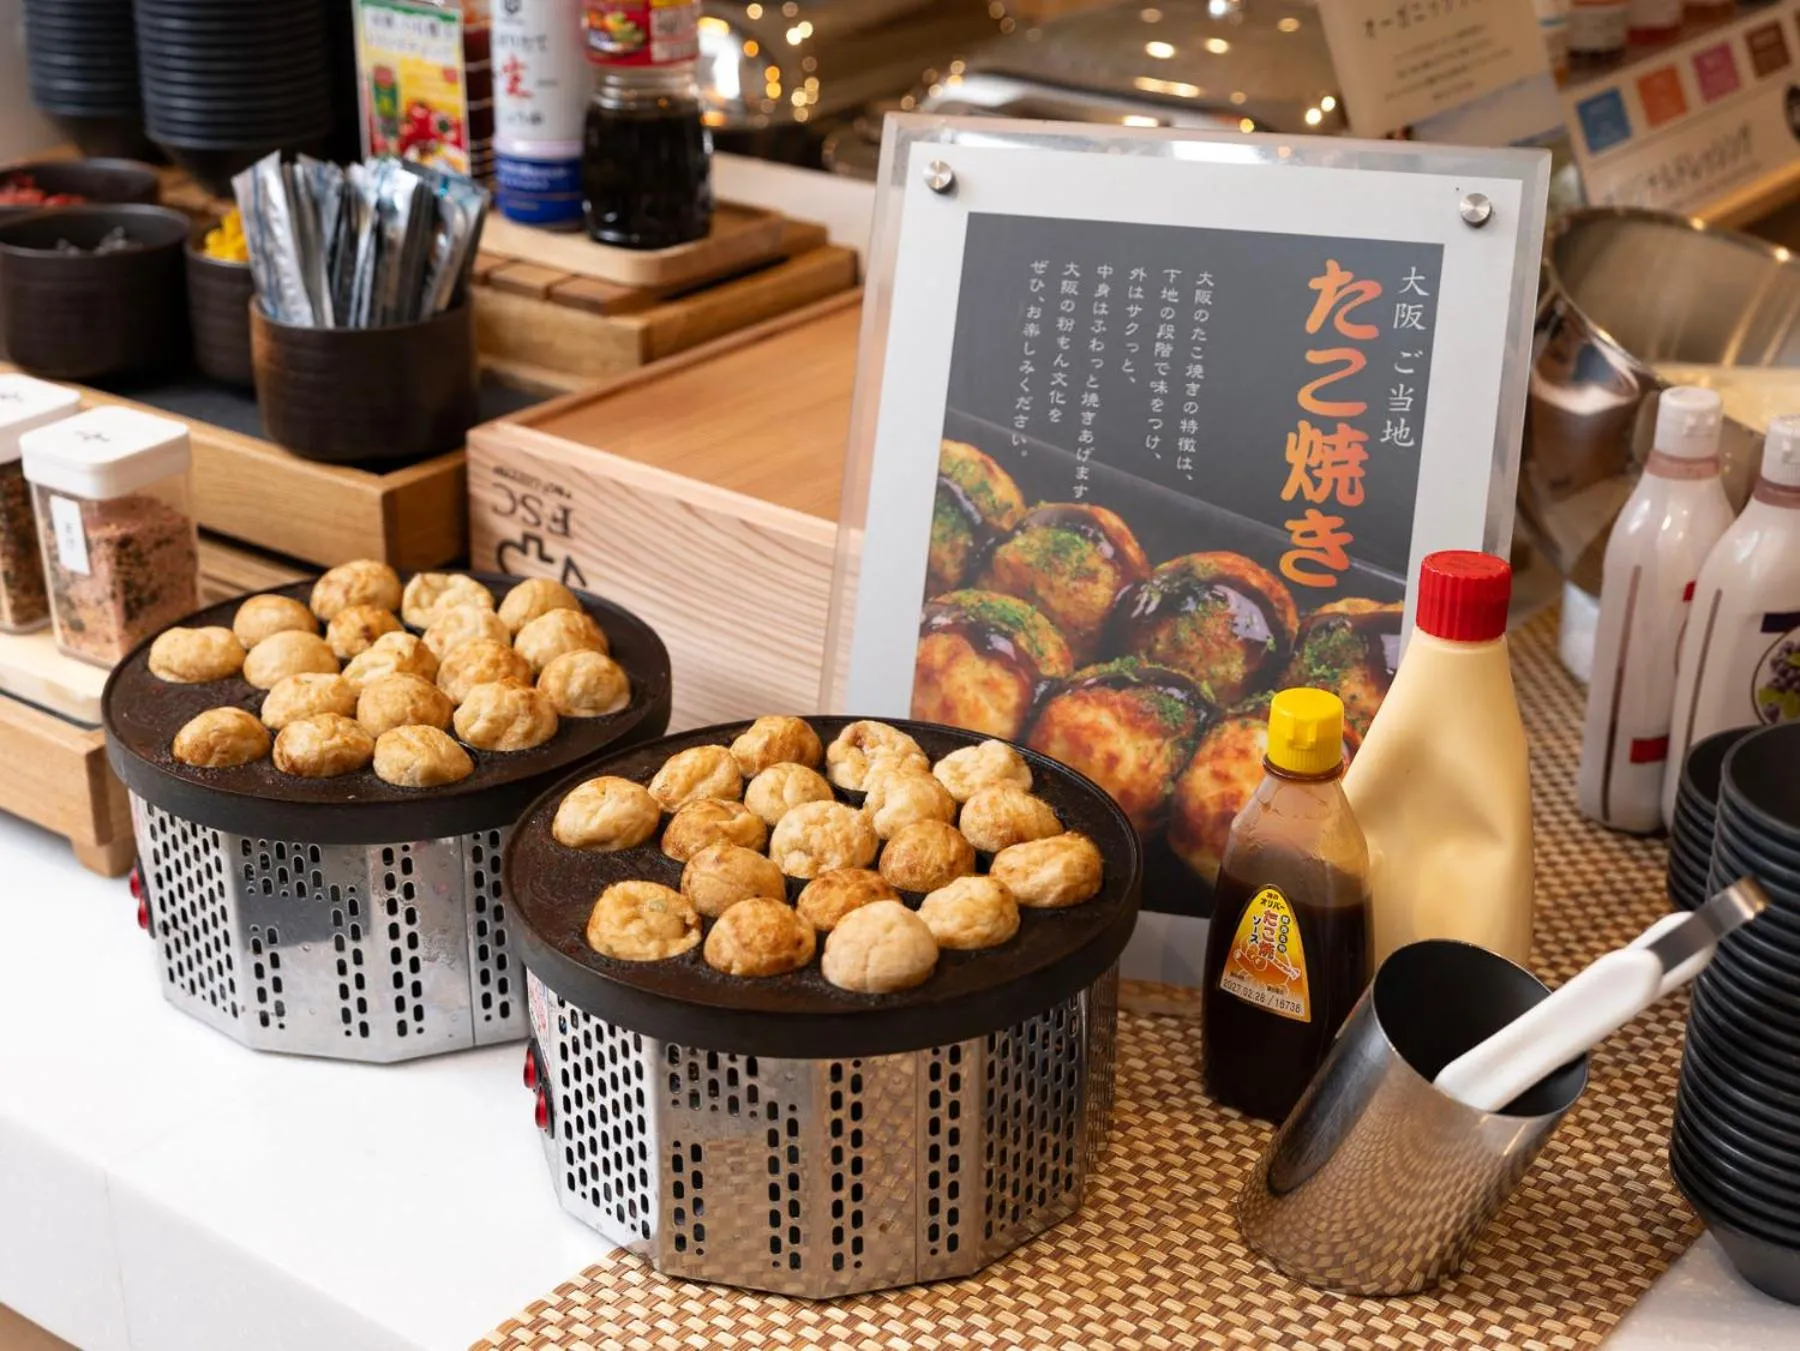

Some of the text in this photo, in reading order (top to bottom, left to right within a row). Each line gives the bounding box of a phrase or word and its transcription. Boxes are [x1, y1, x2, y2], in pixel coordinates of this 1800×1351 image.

[1012, 260, 1049, 457] ぜひ、お楽しみください。
[1048, 260, 1081, 423] 大阪の粉もん文化を
[1072, 263, 1114, 499] 中身はふわっと焼きあげます
[1121, 266, 1147, 383] 外はサクっと、
[1145, 268, 1182, 460] 下地の段階で味をつけ、
[1176, 271, 1215, 481] 大阪のたこ焼きの特徴は、
[1380, 265, 1430, 447] 大阪 ご当地
[492, 482, 572, 538] FSC
[1279, 258, 1383, 588] たこ焼き
[1249, 915, 1261, 944] ソース
[1260, 898, 1286, 910] オリバー
